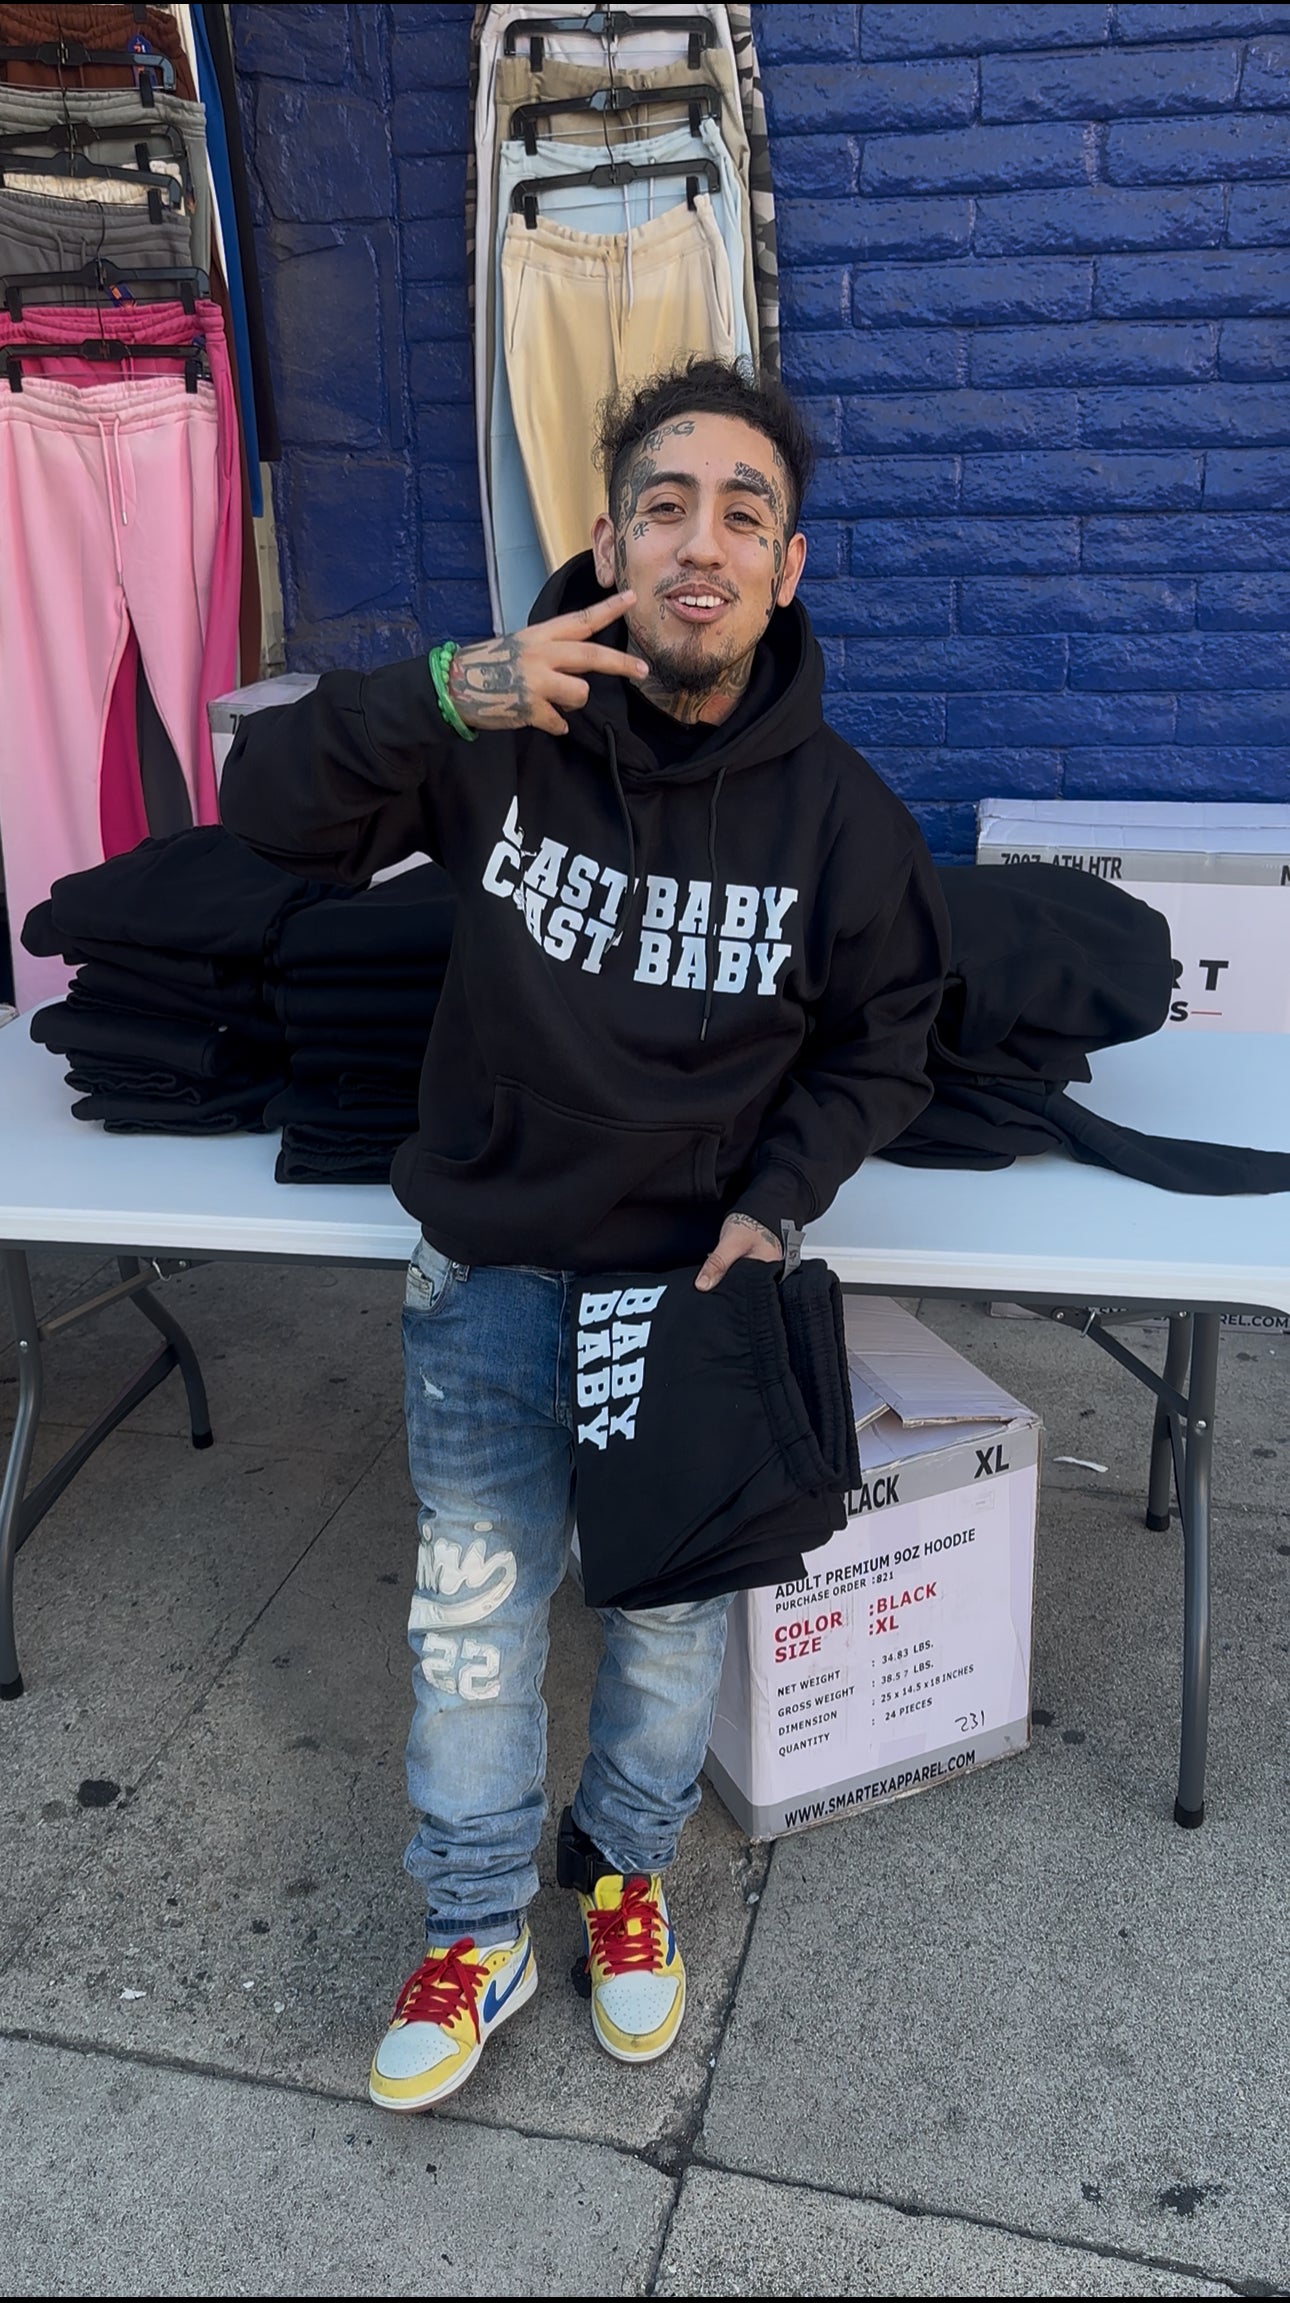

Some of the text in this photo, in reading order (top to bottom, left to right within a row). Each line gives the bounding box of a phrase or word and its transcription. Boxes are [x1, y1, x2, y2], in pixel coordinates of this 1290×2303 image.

[1052, 854, 1084, 871] ATH
[1089, 856, 1122, 879] HTR
[482, 840, 792, 996] CAST BABY
[642, 875, 798, 941] BABY
[576, 1289, 623, 1451] BABY
[609, 1285, 668, 1441] BABY
[847, 1444, 1010, 1517] LACK XL
[775, 1574, 821, 1599] ADULT
[826, 1554, 890, 1585] PREMIUM
[924, 1528, 976, 1556] HOODIE
[775, 1590, 829, 1613] PURCHASE
[833, 1578, 866, 1597] ORDER
[774, 1611, 843, 1644] COLOR
[774, 1636, 822, 1663] SIZE
[777, 1683, 797, 1697] NET
[800, 1669, 841, 1690] WEIGHT
[881, 1649, 909, 1665] 34.83
[778, 1710, 838, 1736] DIMENSION
[880, 1692, 892, 1703] 25
[902, 1682, 922, 1697] 14.5
[942, 1664, 974, 1683] INCHES
[778, 1700, 812, 1717] GROSS
[814, 1686, 855, 1707] WEIGHT
[778, 1732, 830, 1757] QUANTITY
[884, 1710, 896, 1721] 24
[899, 1697, 933, 1716] PIECES
[784, 1749, 976, 1828] WWW.SMARTEXAPPAREL.COM
